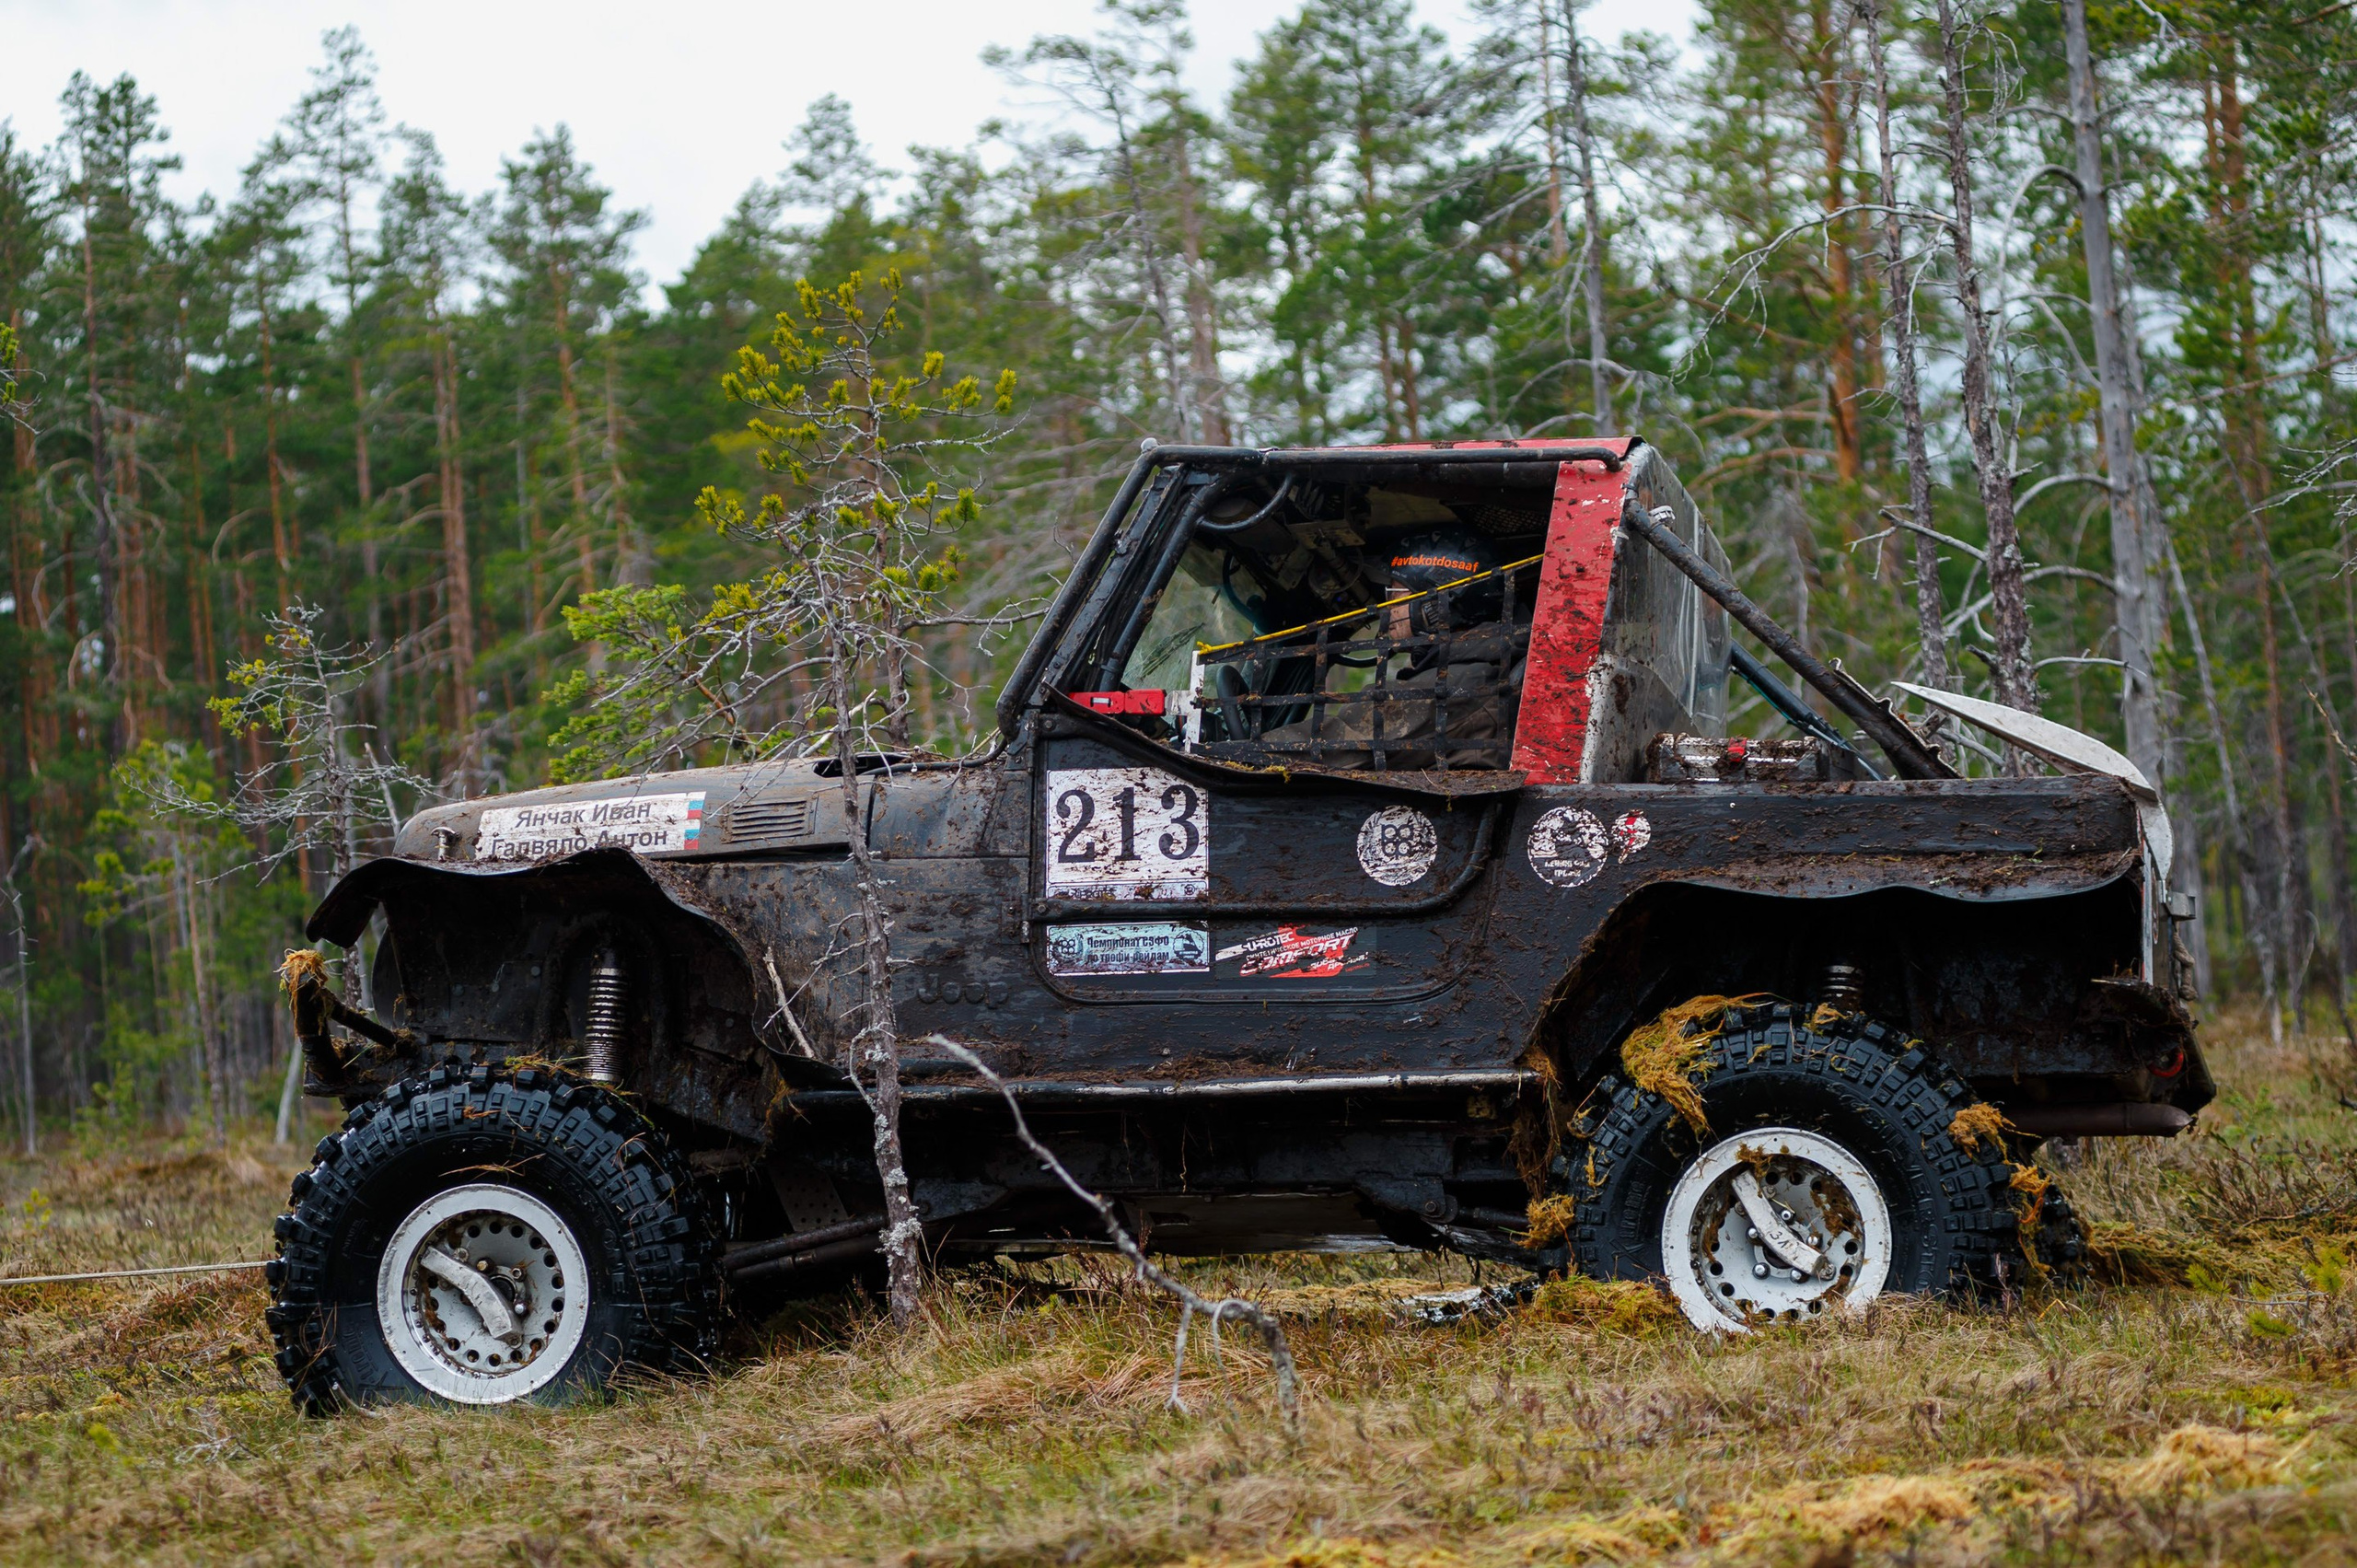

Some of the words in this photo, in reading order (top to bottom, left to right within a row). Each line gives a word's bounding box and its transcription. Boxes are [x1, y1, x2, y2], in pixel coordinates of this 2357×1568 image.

[1390, 554, 1480, 573] #avtokotdosaaf
[516, 809, 586, 828] Янчак
[591, 802, 652, 821] Иван
[1056, 784, 1200, 864] 213
[597, 830, 668, 848] Антон
[1087, 935, 1140, 948] Чемпионат
[1300, 933, 1336, 947] МОТОРНОЕ
[1335, 926, 1358, 938] МАСЛО
